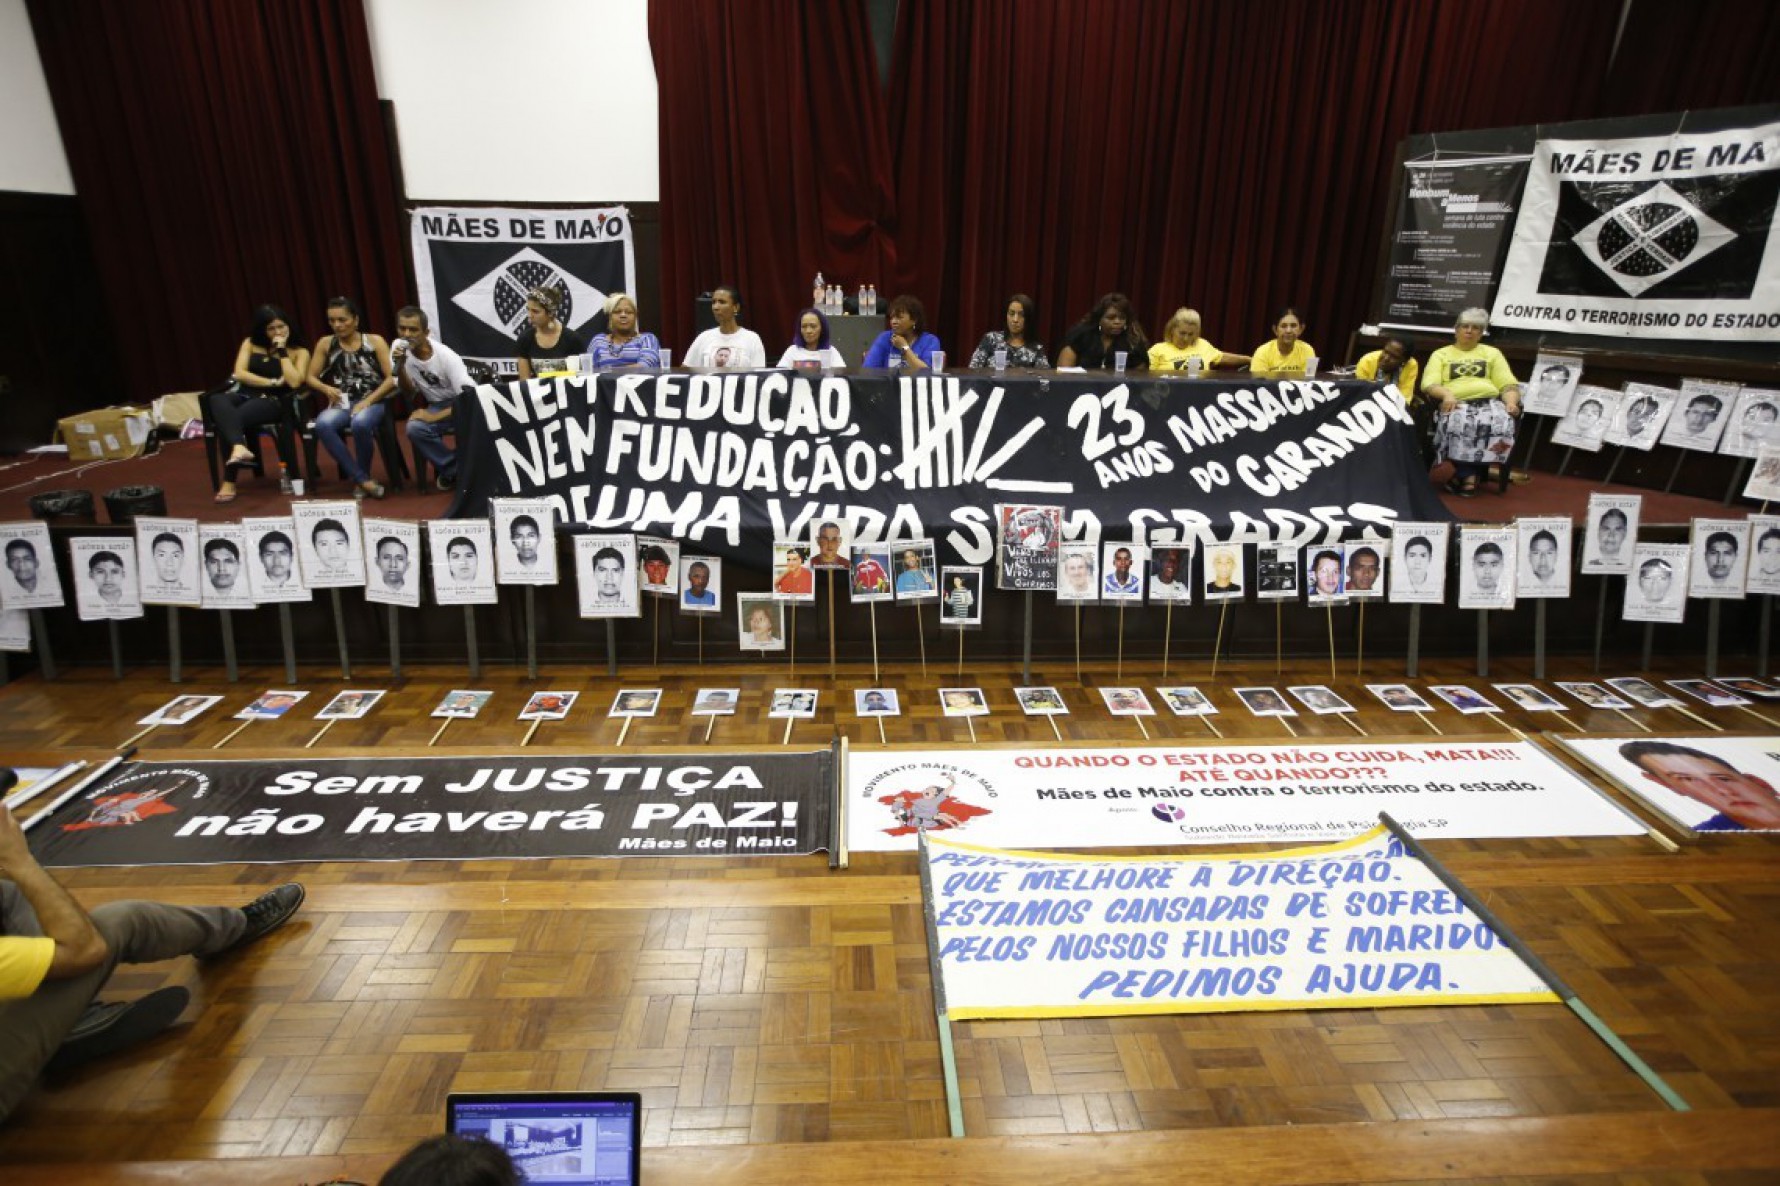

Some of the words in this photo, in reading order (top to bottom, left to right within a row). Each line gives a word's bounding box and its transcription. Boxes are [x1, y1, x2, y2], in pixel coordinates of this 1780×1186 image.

[1551, 150, 1641, 174] MÃES
[1652, 148, 1696, 172] DE
[1705, 142, 1766, 167] MA
[421, 213, 499, 237] MÃES
[509, 218, 546, 238] DE
[1503, 305, 1561, 320] CONTRA
[1565, 308, 1576, 321] O
[1581, 309, 1680, 327] TERRORISMO
[1685, 314, 1707, 327] DO
[1712, 313, 1780, 328] ESTADO
[474, 374, 600, 431] NEM
[1167, 380, 1341, 454] MASSACRE
[1067, 383, 1146, 462] 23
[1094, 440, 1175, 489] ANOS
[1189, 460, 1231, 493] DO
[586, 484, 742, 546] UMA
[1014, 756, 1130, 768] QUANDO
[1138, 755, 1157, 766] O
[1165, 752, 1266, 766] ESTADO
[1272, 749, 1329, 765] NÃO
[1335, 750, 1425, 765] CUIDA,
[1426, 748, 1521, 763] MATA!!!
[1179, 767, 1228, 783] ATÉ
[1234, 765, 1388, 782] QUANDO???
[264, 771, 424, 796] Sem
[445, 765, 764, 796] JUSTIÇA
[862, 764, 917, 798] MOVIMENTO
[961, 769, 978, 778] DE
[1037, 787, 1097, 800] Mães
[1103, 787, 1131, 799] de
[1138, 786, 1194, 798] Maio
[1200, 784, 1274, 797] contra
[1281, 786, 1295, 795] o
[1300, 781, 1420, 796] terrorismo
[1429, 780, 1455, 794] do
[1461, 780, 1544, 793] estado.
[175, 807, 325, 837] não
[344, 804, 604, 834] haverá
[631, 801, 799, 830] PAZ!
[1179, 823, 1251, 834] Conselho
[1255, 820, 1324, 833] Regional
[1327, 820, 1347, 831] de
[1428, 818, 1448, 828] SP
[619, 836, 687, 850] Mães
[690, 836, 728, 849] de
[736, 835, 797, 849] Maio
[941, 871, 1010, 897] QUE
[1018, 866, 1179, 892] MELHORE
[1190, 866, 1213, 887] A
[937, 898, 1093, 926] ESTAMOS
[1104, 894, 1269, 923] CANSADAS
[1285, 892, 1329, 918] DE
[938, 935, 1037, 962] PELOS
[1046, 931, 1169, 961] NOSSOS
[1182, 928, 1290, 958] FILHOS
[1307, 926, 1330, 952] E
[1078, 965, 1283, 999] PEDIMOS
[1305, 962, 1460, 993] AJUDA.
